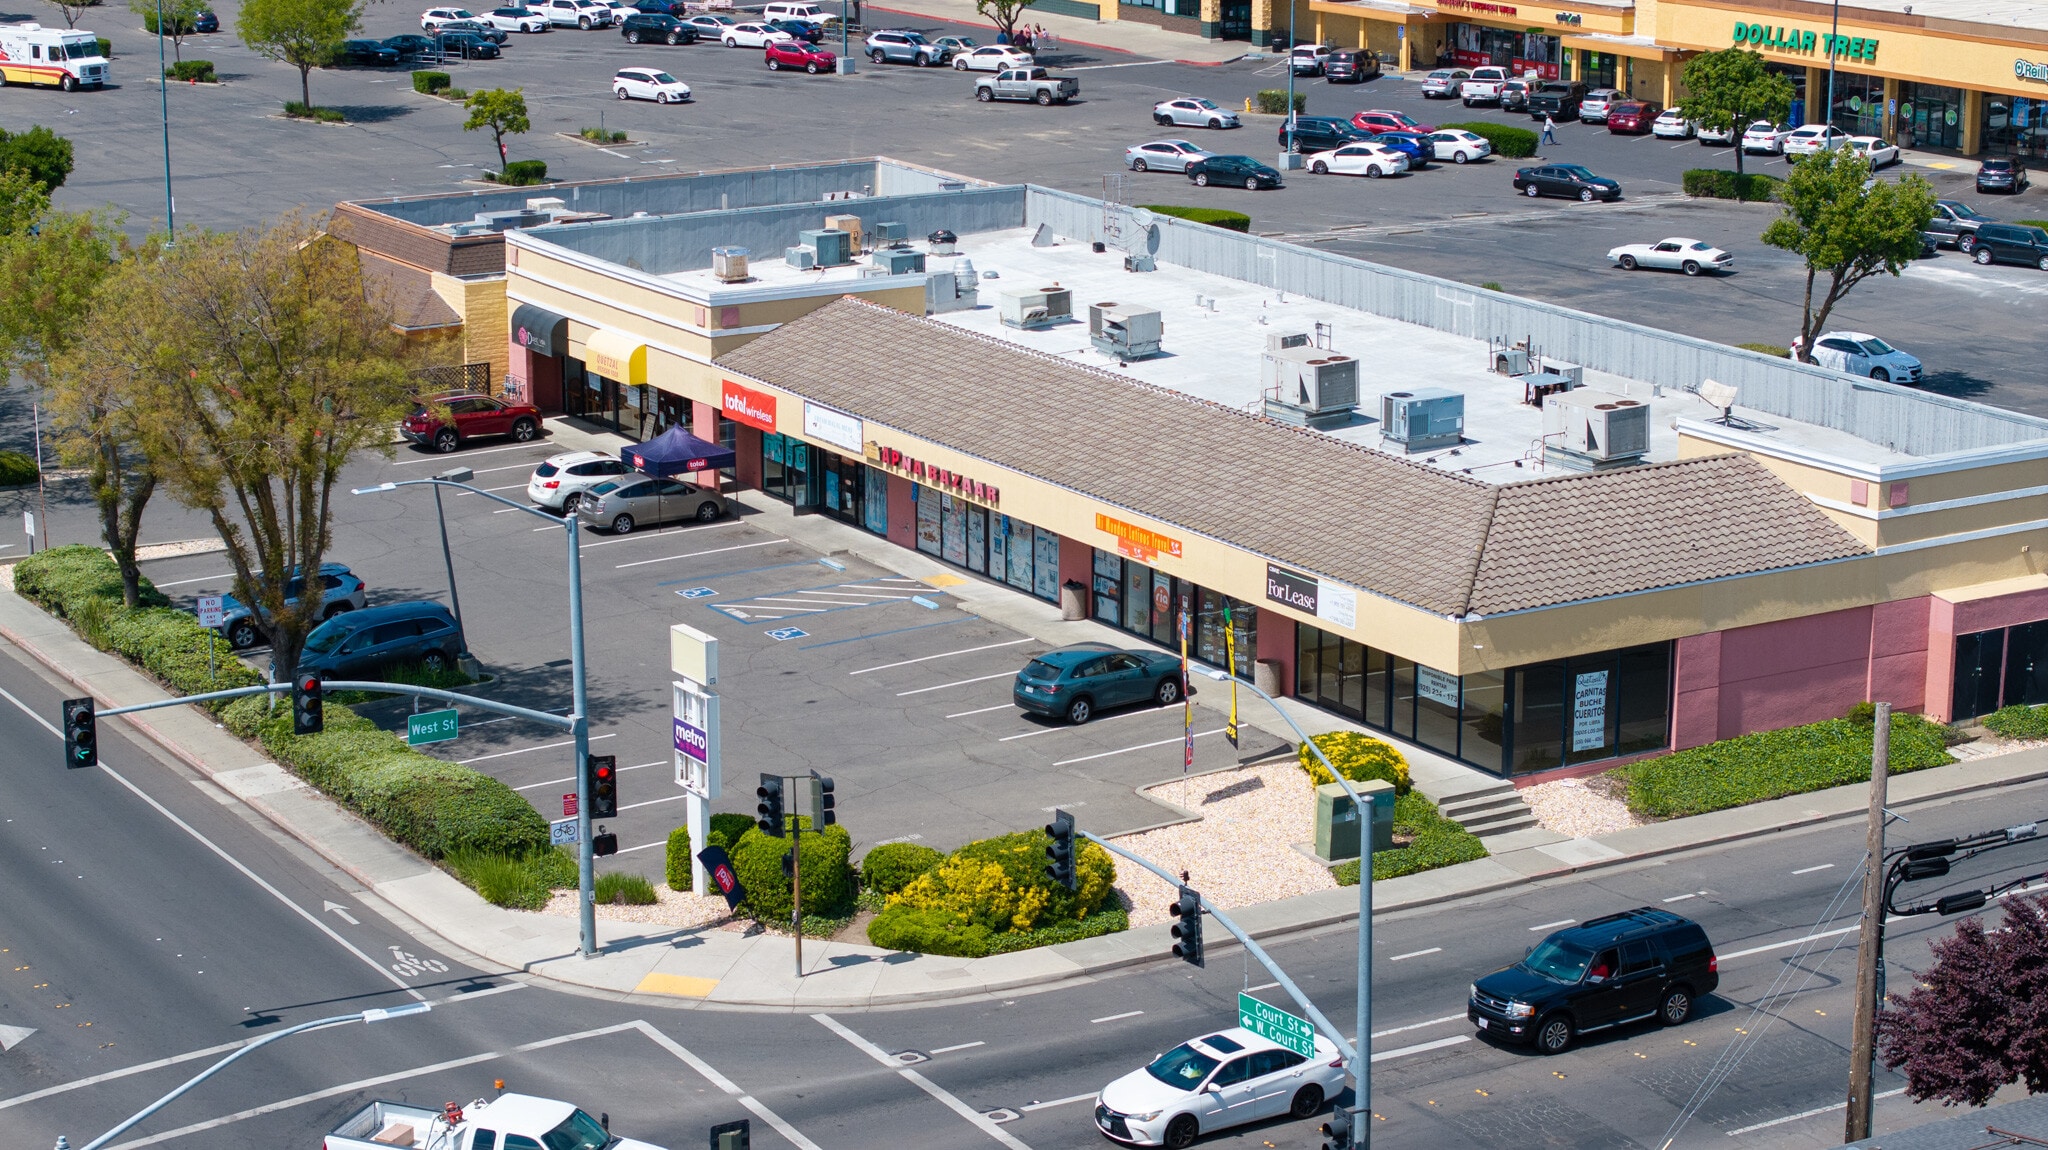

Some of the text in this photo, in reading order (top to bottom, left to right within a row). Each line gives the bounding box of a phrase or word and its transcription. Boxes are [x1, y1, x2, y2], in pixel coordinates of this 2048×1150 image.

[1732, 21, 1878, 60] DOLLAR TREE
[725, 393, 773, 424] total wireless
[882, 446, 924, 476] APNA
[928, 464, 998, 503] BAZAAR
[1152, 532, 1170, 553] Travel
[1155, 589, 1168, 604] ria
[1268, 578, 1285, 599] For
[1284, 584, 1315, 610] Lease
[1576, 687, 1606, 700] CARNITAS
[1579, 698, 1602, 708] BUCHE
[1574, 706, 1605, 719] CUERITOS
[411, 719, 454, 736] West St
[675, 724, 706, 750] metro
[1255, 1002, 1299, 1034] Court St
[1256, 1019, 1313, 1057] W. Court St
